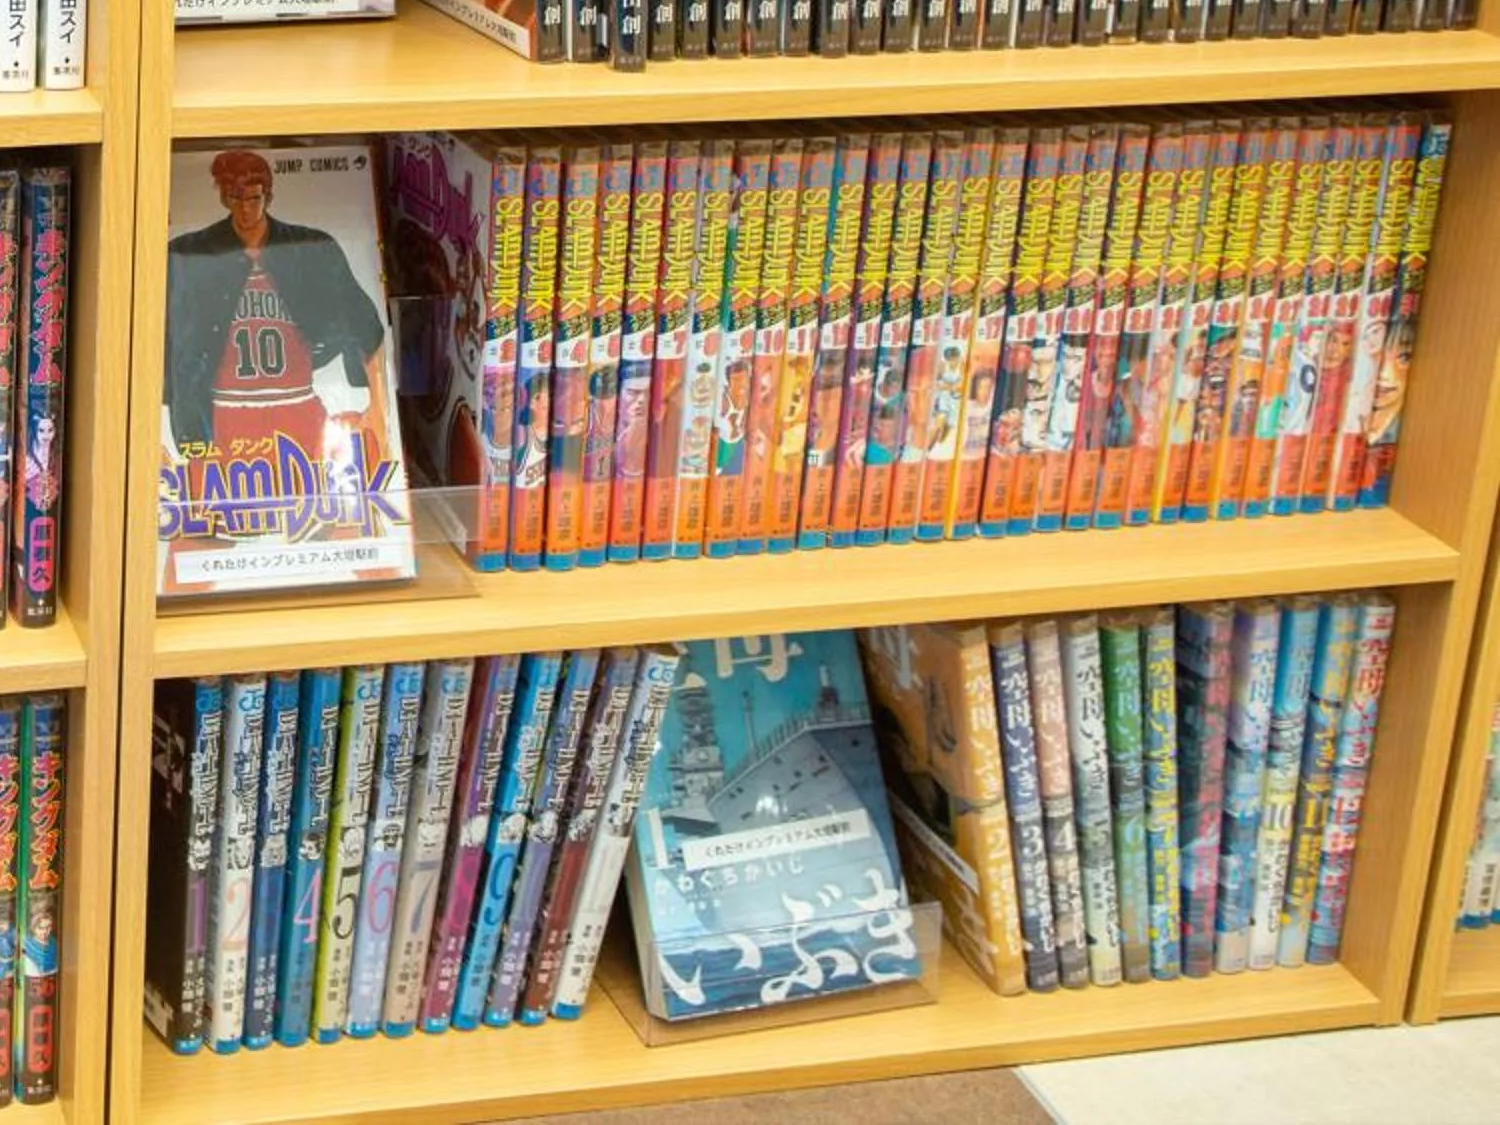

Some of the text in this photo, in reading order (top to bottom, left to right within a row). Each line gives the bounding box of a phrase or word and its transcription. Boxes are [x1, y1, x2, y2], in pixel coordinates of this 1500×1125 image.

[274, 158, 349, 174] JUMP COMICS
[30, 230, 64, 385] キングダム
[235, 327, 285, 379] 10
[177, 439, 276, 462] スラム ダンク
[1023, 826, 1044, 855] 3
[1055, 823, 1075, 850] 4
[223, 877, 248, 952] 2
[293, 867, 321, 943] 4
[332, 866, 357, 939] 5
[368, 860, 399, 933] 6
[411, 859, 440, 932] 7
